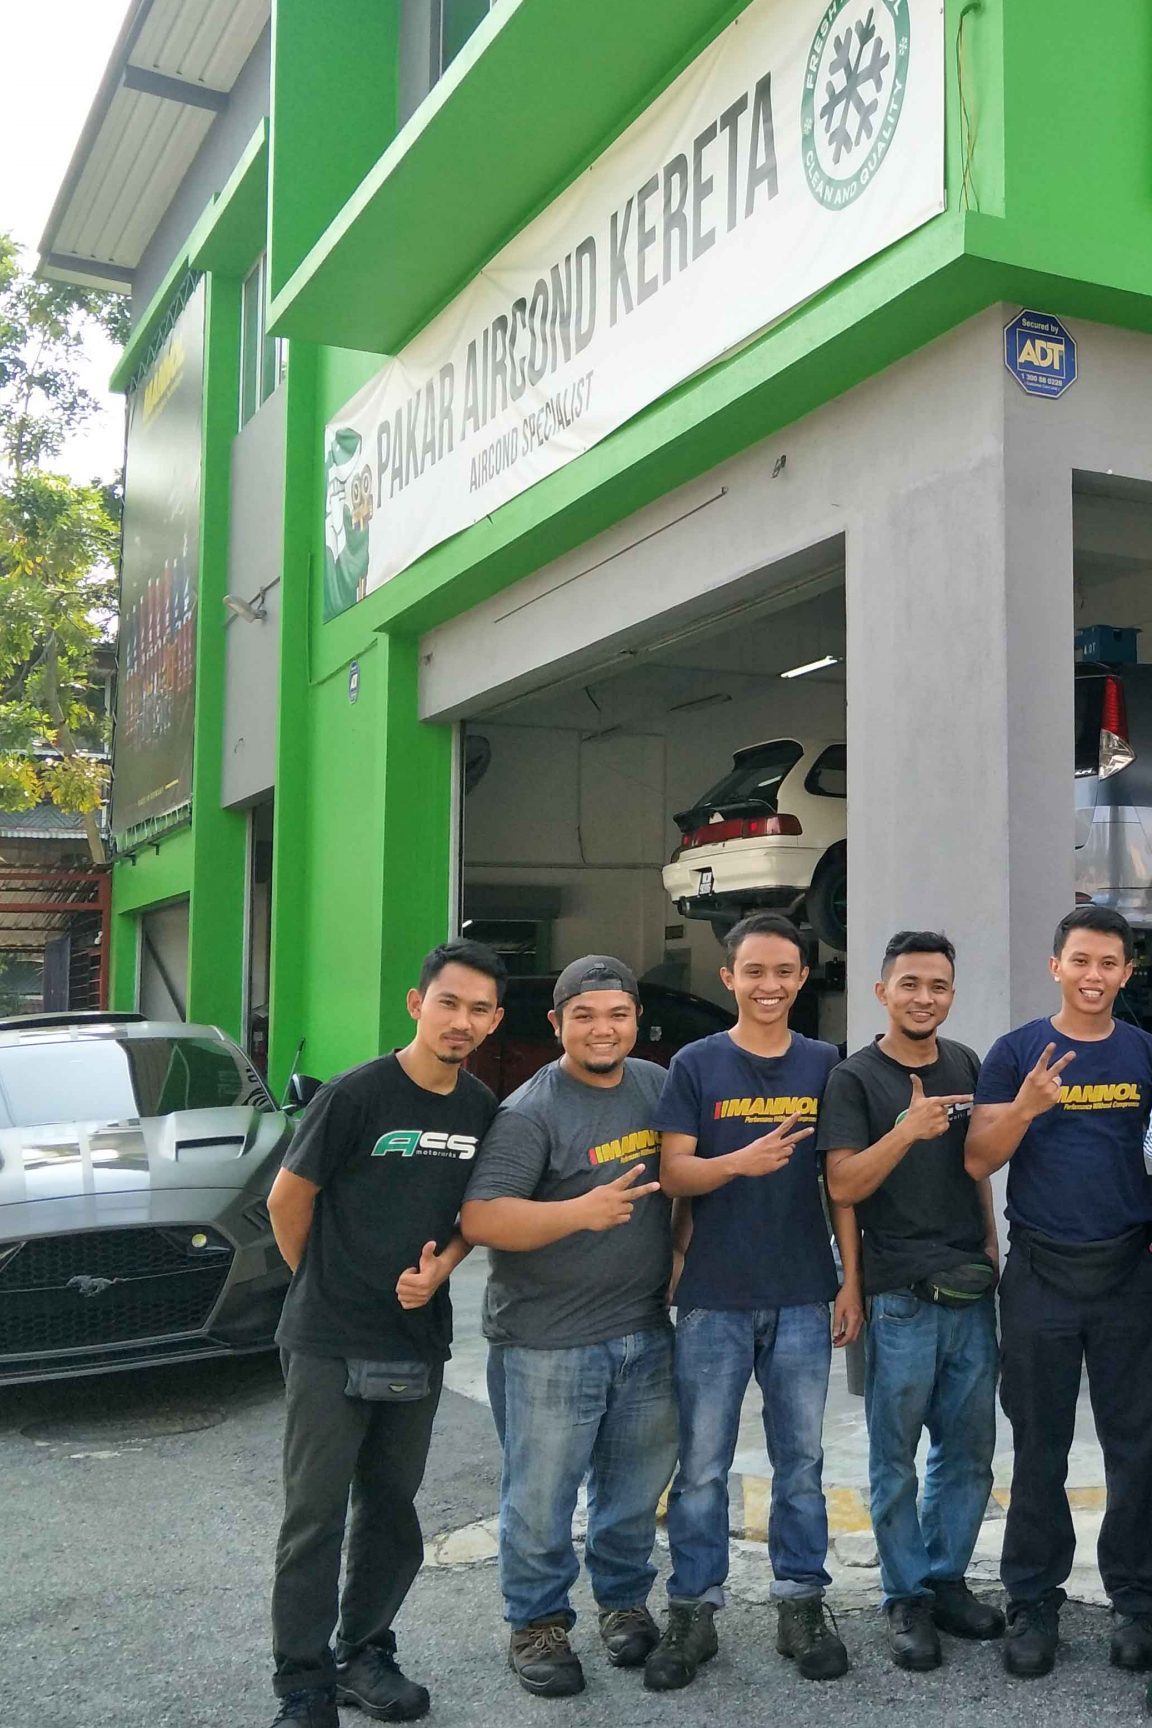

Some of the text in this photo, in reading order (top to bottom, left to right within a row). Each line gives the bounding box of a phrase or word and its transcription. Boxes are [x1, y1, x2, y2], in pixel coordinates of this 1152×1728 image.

[806, 4, 838, 89] FRESH
[806, 78, 903, 205] CLEAN AND QUALITY
[376, 362, 455, 509] PAKAR
[460, 234, 598, 442] AIRCOND
[608, 71, 780, 329] KERETA
[1021, 318, 1059, 335] Secured by
[1018, 338, 1064, 370] ADT
[469, 369, 594, 494] AIRCOND SPECIALIST
[371, 1130, 479, 1160] ACS
